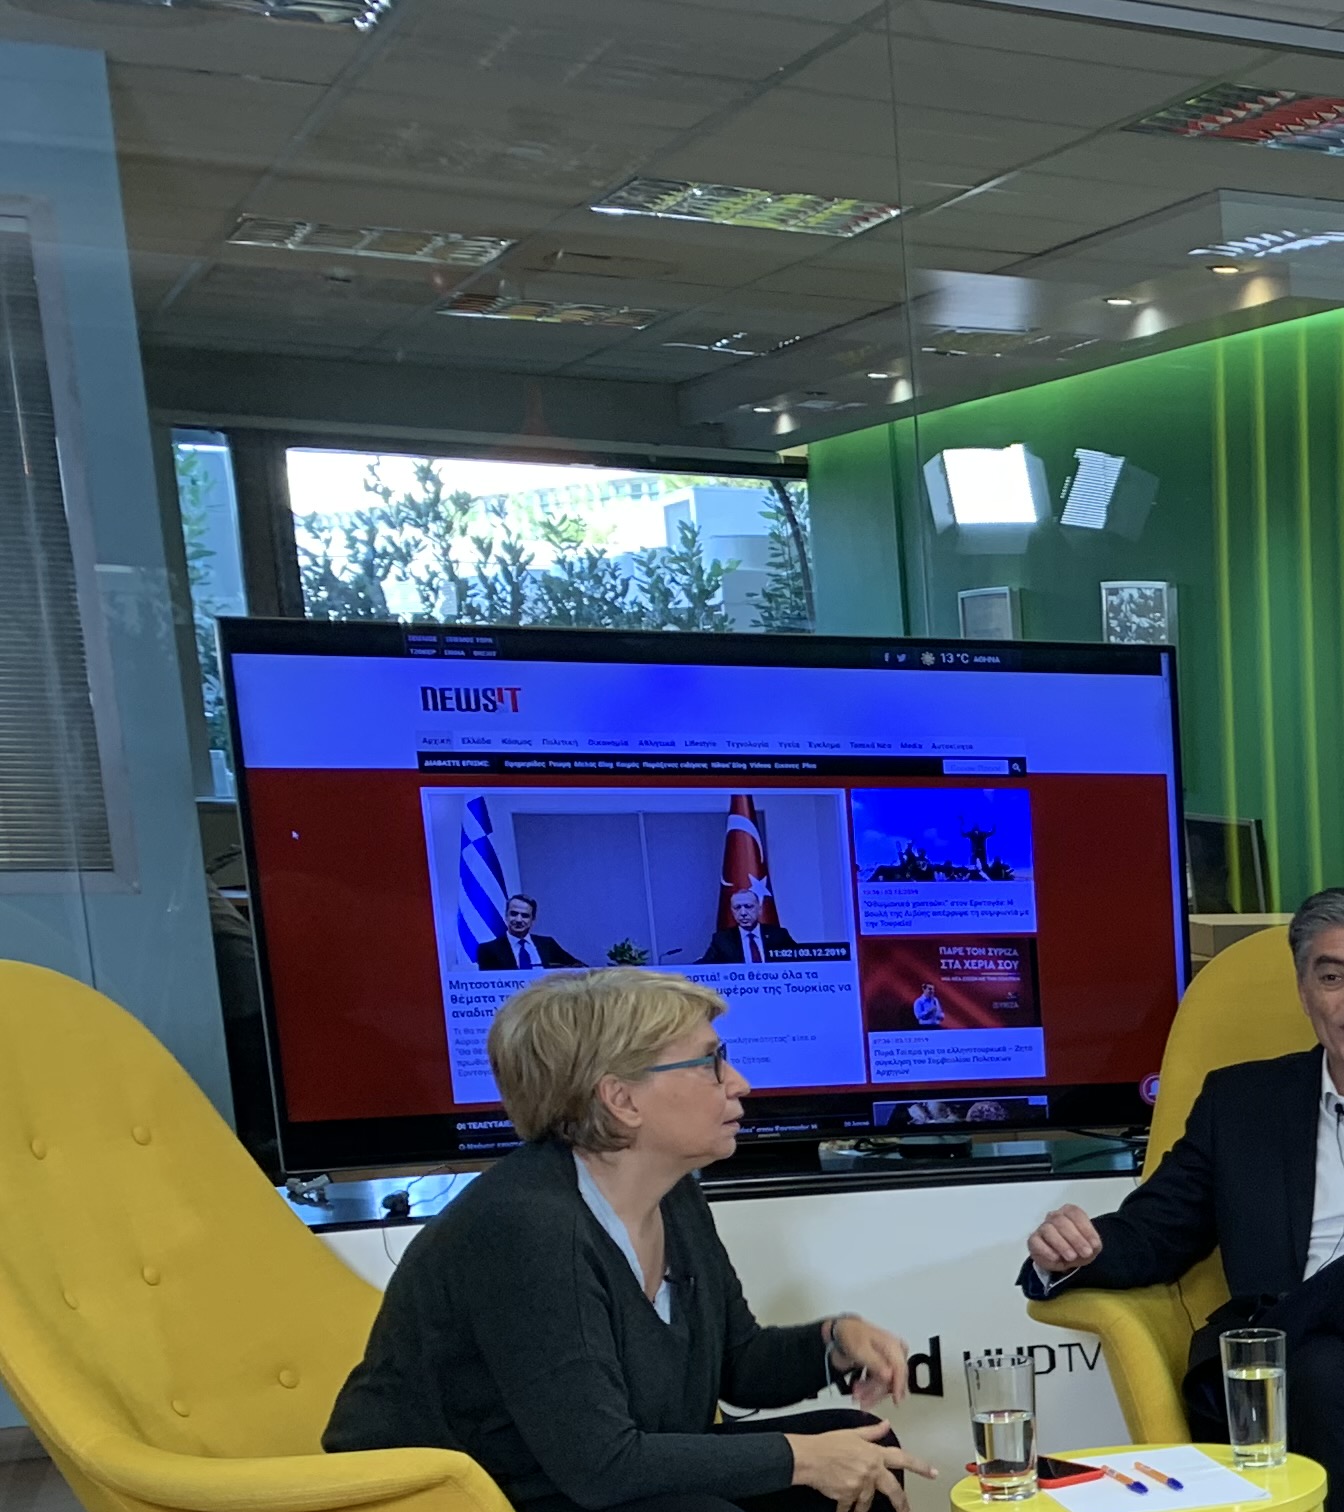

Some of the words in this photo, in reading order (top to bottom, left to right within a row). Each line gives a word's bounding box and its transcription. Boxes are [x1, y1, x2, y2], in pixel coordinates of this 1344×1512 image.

[940, 652, 954, 664] 13
[769, 948, 793, 958] 11:02
[798, 947, 847, 958] 03.12.2019
[939, 946, 965, 956] ΠΑΡΕ
[965, 947, 986, 956] ΤΟΝ
[987, 947, 1019, 957] ΣΥΡΙΖΑ
[940, 959, 962, 970] ΣΤΑ
[963, 959, 996, 970] ΧΕΡΙΑ
[997, 960, 1020, 970] ΣΟΥ
[685, 972, 721, 984] αρτιά!
[747, 970, 779, 981] θέσω
[781, 970, 803, 981] όλα
[804, 971, 819, 980] τα
[448, 979, 525, 991] Μητσοτάκης
[715, 983, 760, 997] μφέρον
[761, 983, 782, 995] της
[783, 983, 836, 994] Τουρκίας
[837, 983, 852, 992] να
[450, 994, 496, 1006] θέματα
[451, 1006, 499, 1018] αναδιπ
